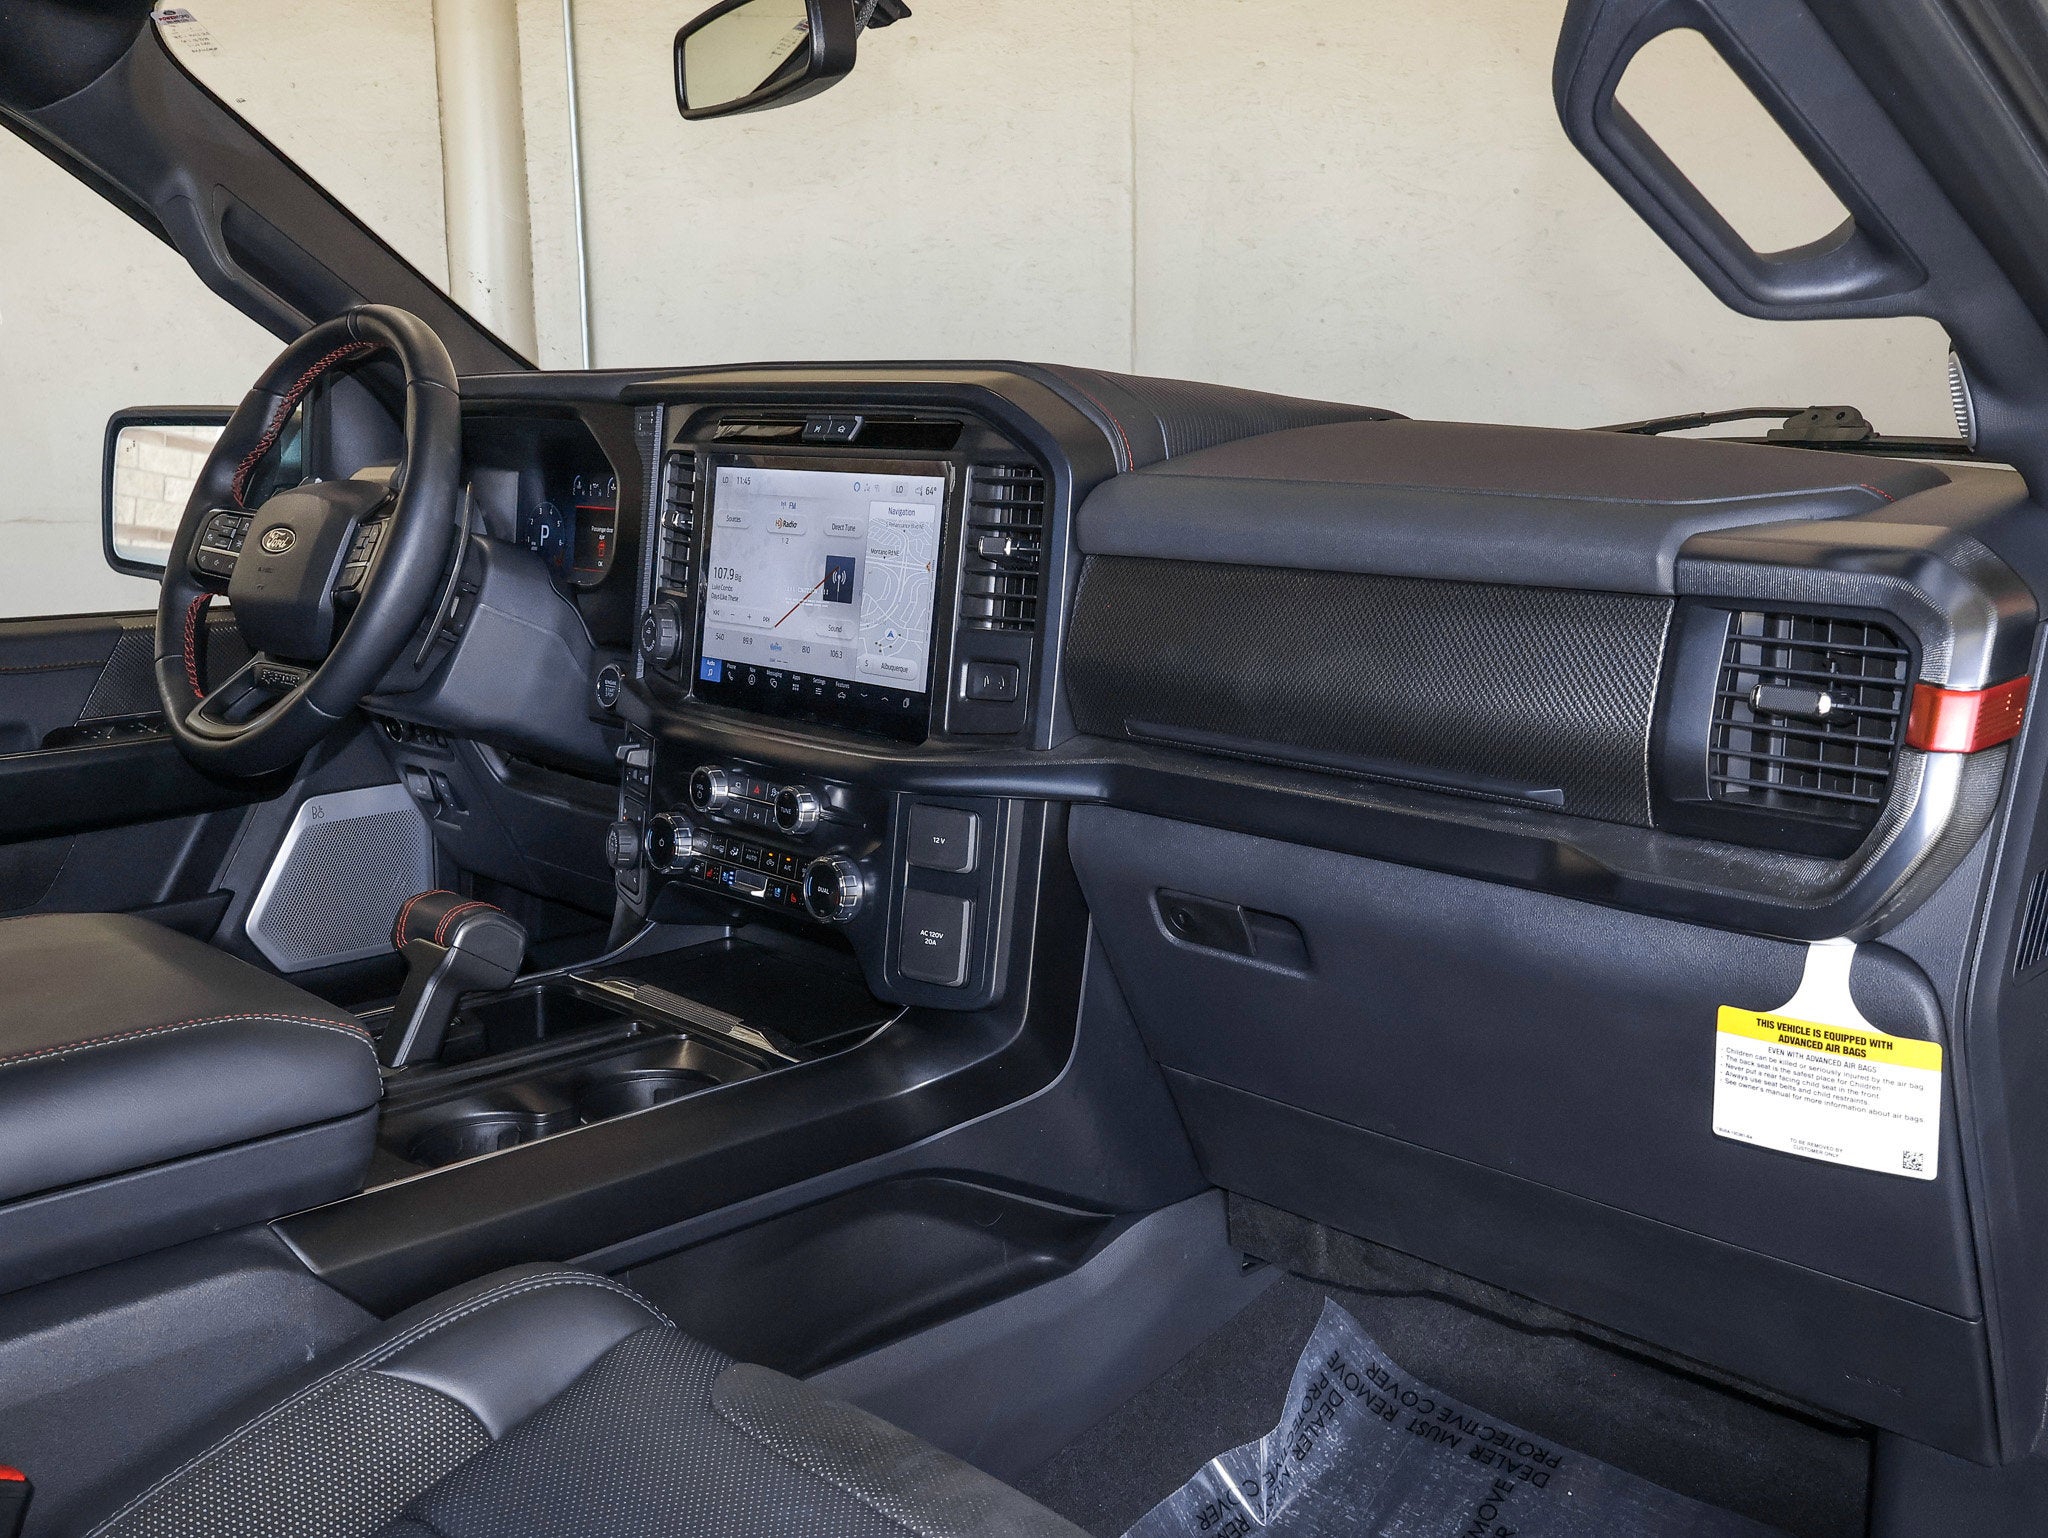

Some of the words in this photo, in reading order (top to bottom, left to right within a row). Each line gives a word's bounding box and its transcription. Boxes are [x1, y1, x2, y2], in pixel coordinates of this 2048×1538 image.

[736, 476, 751, 485] 11:45
[726, 514, 742, 522] Sources
[888, 507, 916, 517] Navigation
[783, 520, 798, 528] Radio
[832, 523, 844, 531] Direct
[844, 524, 856, 532] Tune
[266, 530, 290, 548] Ford
[540, 525, 550, 546] P
[714, 566, 735, 580] 107.9
[716, 633, 724, 641] 540
[828, 624, 842, 632] Sound
[830, 650, 843, 659] 106.3
[881, 662, 908, 674] Albuquerque
[781, 806, 792, 814] TUNE
[818, 886, 830, 894] DUAL
[920, 929, 928, 937] AC
[924, 938, 937, 946] 20A
[1756, 1018, 1774, 1029] THIS
[1777, 1022, 1811, 1036] VEHICLE
[1813, 1029, 1821, 1038] IS
[1824, 1031, 1867, 1046] EQUIPPED
[1869, 1039, 1893, 1050] WITH
[1778, 1034, 1823, 1050] ADVANCED
[1825, 1043, 1840, 1053] AIR
[1843, 1046, 1866, 1058] BAGS
[1726, 1047, 1754, 1058] Children
[1779, 1059, 1797, 1068] killed
[1809, 1065, 1841, 1077] seriously
[1844, 1072, 1869, 1082] injured
[1871, 1075, 1880, 1084] by
[1883, 1077, 1894, 1086] the
[1768, 1046, 1785, 1056] EVEN
[1787, 1050, 1804, 1059] WITH
[1806, 1054, 1841, 1067] ADVANCED
[1844, 1061, 1856, 1069] AIR
[1858, 1064, 1877, 1074] BAGS
[1726, 1063, 1744, 1071] Never
[1764, 1072, 1777, 1080] rear
[1779, 1074, 1800, 1085] facing
[1802, 1079, 1820, 1088] child
[1822, 1083, 1837, 1092] seat
[1848, 1088, 1859, 1096] the
[1739, 1058, 1754, 1066] back
[1793, 1071, 1814, 1079] safest
[1816, 1074, 1835, 1083] place
[1725, 1070, 1748, 1081] Always
[1764, 1080, 1778, 1088] seat
[1780, 1083, 1796, 1092] belts
[1798, 1087, 1811, 1095] and
[1813, 1090, 1830, 1098] child
[1725, 1078, 1736, 1086] See
[1766, 1088, 1790, 1098] manual
[1804, 1097, 1822, 1105] more
[1824, 1101, 1866, 1113] information
[1869, 1109, 1890, 1117] about
[1793, 1145, 1823, 1155] CUSTOMER
[1807, 1142, 1834, 1152] REMOVED
[1327, 1350, 1399, 1423] REMOVE
[1366, 1362, 1435, 1414] COVER
[1263, 1372, 1329, 1489] PROTECTIVE
[1292, 1389, 1344, 1461] DEALER
[1405, 1418, 1463, 1449] MUST
[1436, 1407, 1563, 1469] PROTECTIVE
[1468, 1444, 1551, 1489] DEALER
[1196, 1480, 1260, 1531] COVER
